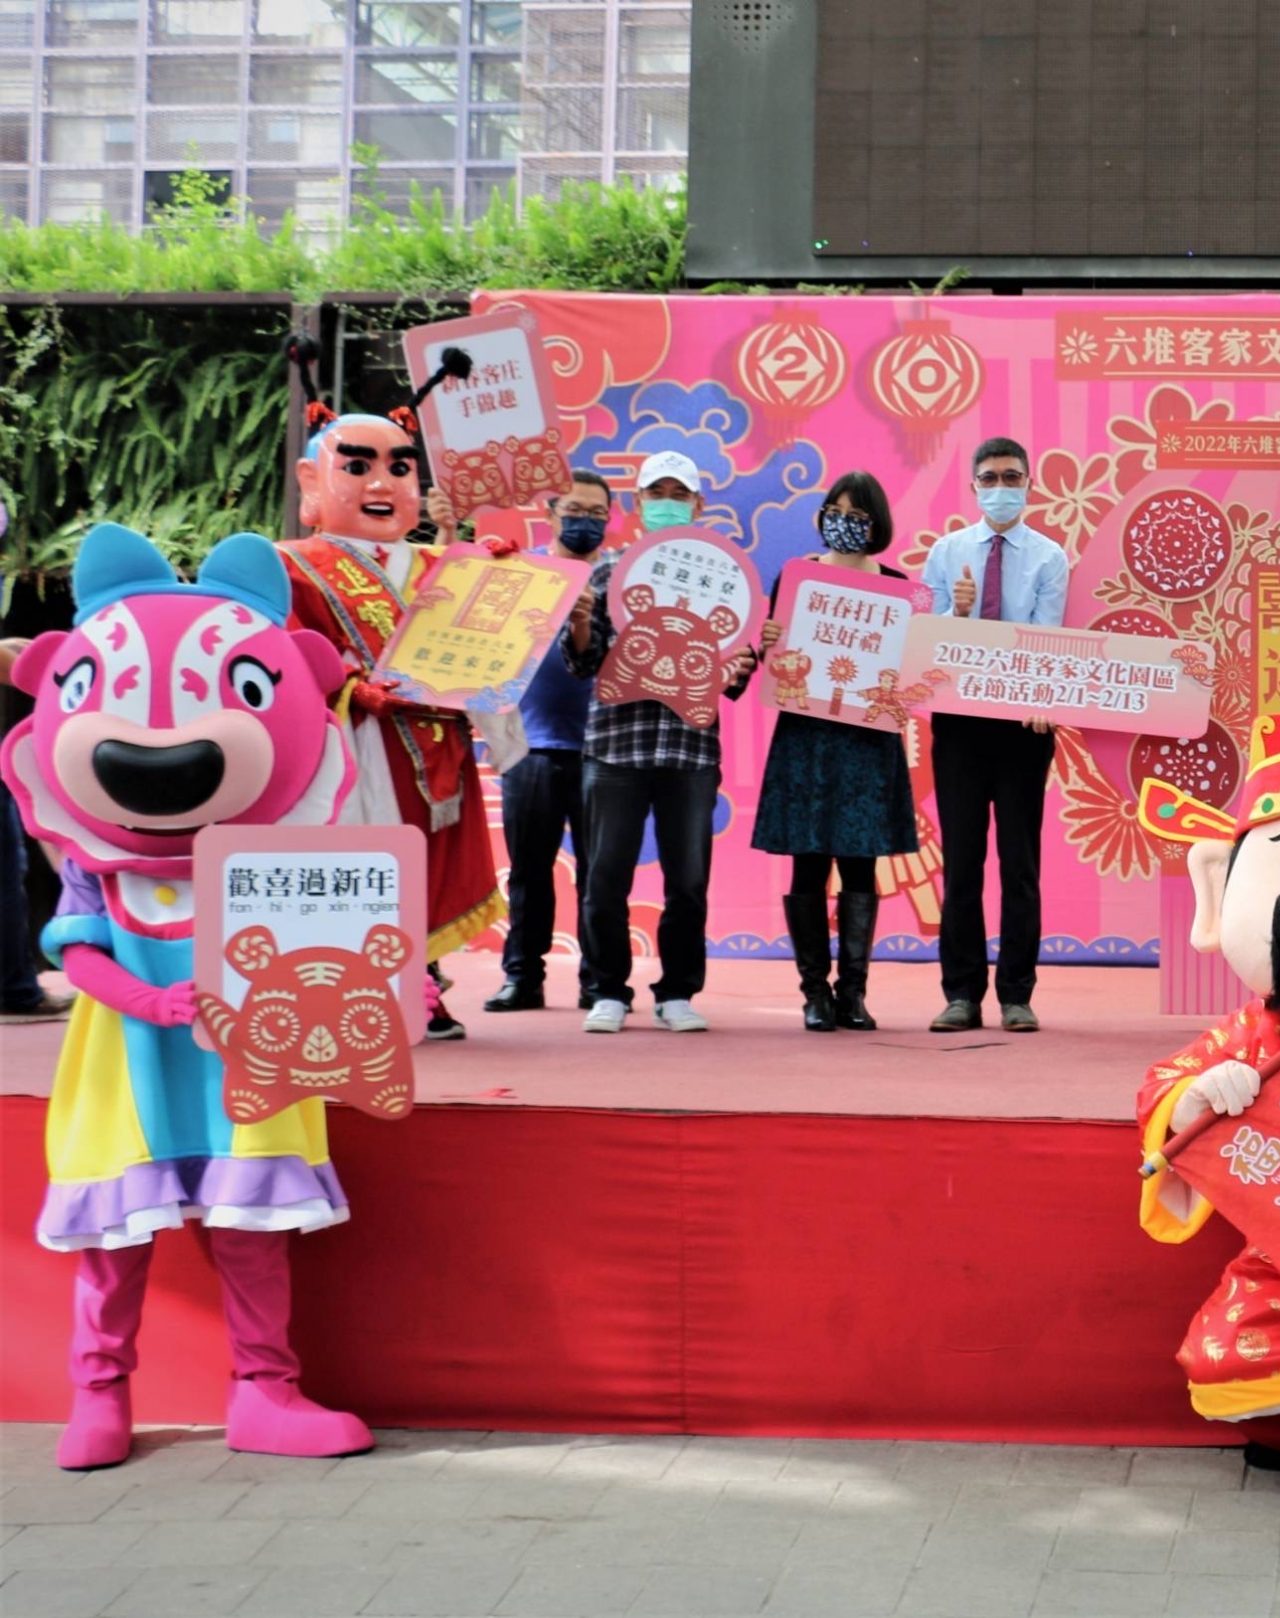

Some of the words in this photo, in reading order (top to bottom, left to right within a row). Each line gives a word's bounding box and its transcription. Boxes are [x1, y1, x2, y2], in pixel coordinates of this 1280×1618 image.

[774, 346, 808, 381] 2
[908, 358, 947, 393] 0
[807, 591, 899, 627] 新春打卡
[812, 620, 882, 654] 送好禮
[937, 645, 1176, 690] 2022六堆客家文化園區
[228, 867, 395, 898] 歡喜過新年
